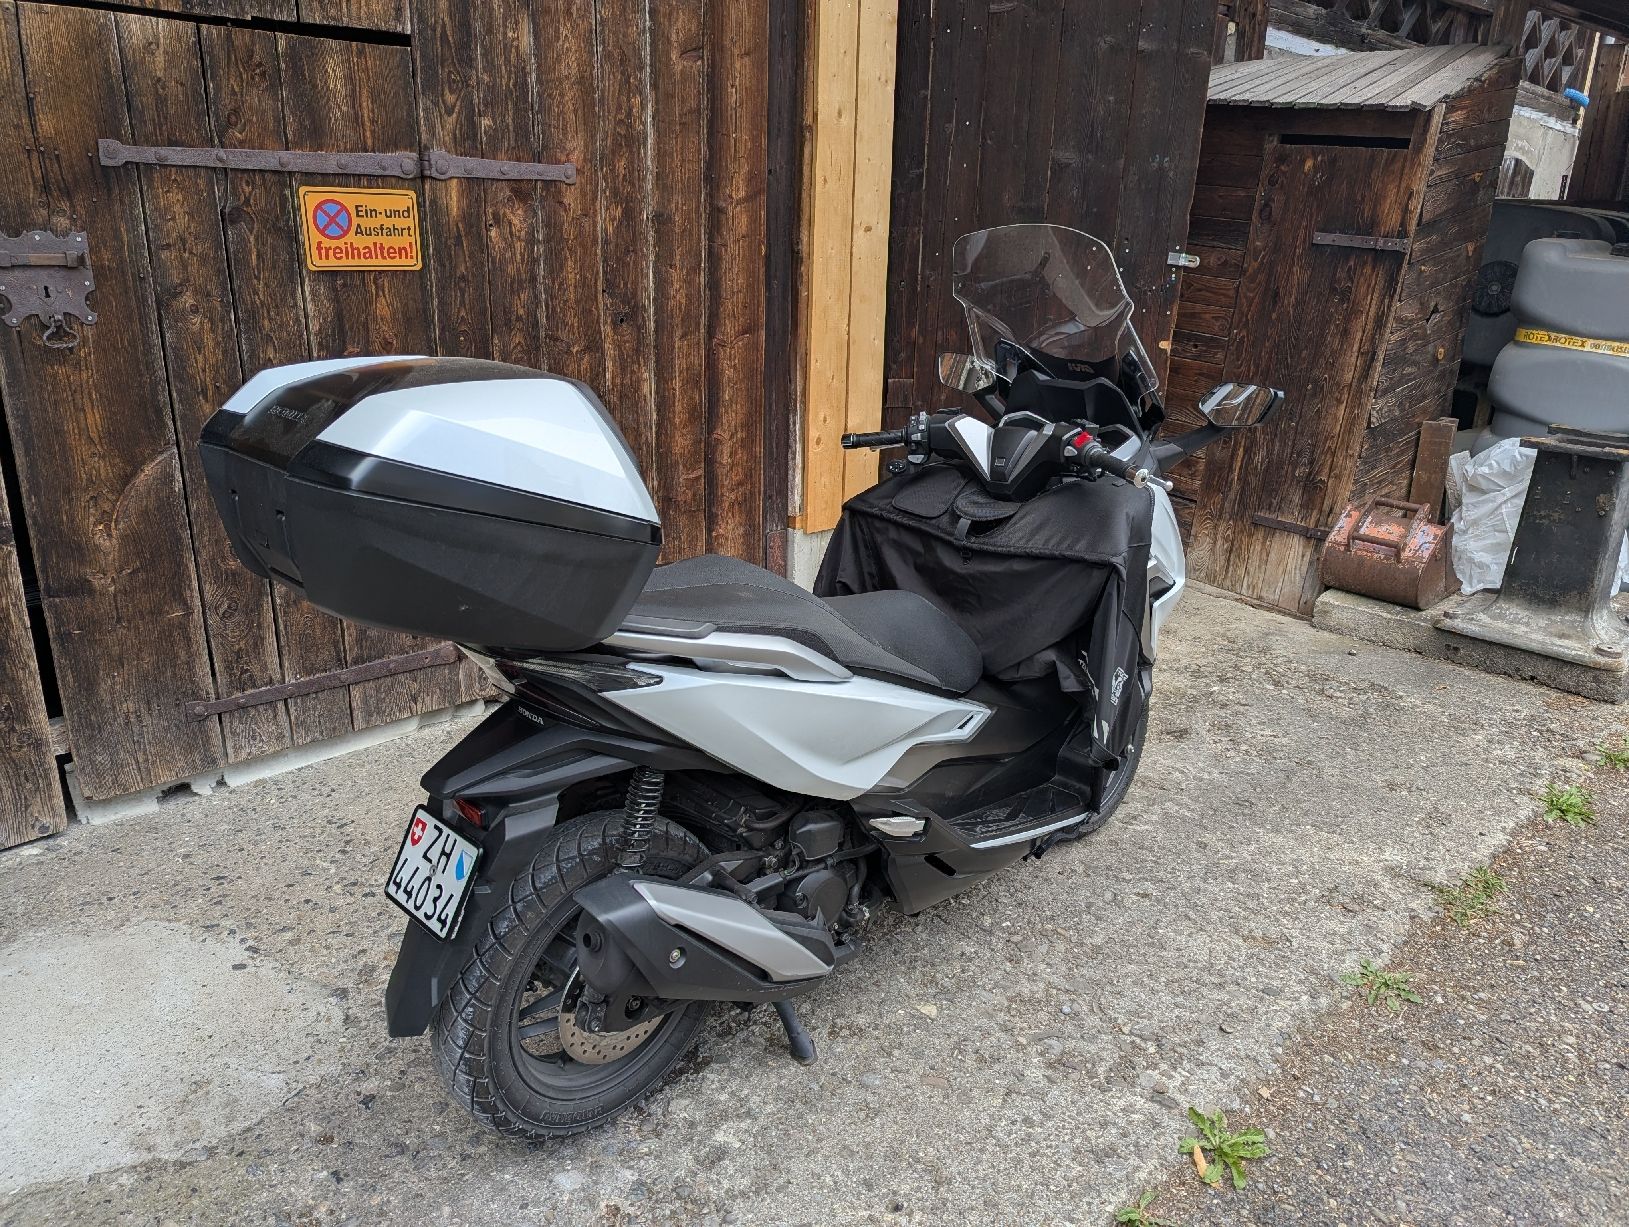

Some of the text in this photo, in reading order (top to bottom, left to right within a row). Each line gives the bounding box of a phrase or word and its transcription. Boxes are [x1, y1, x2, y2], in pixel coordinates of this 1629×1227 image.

[354, 223, 413, 237] Ausfahrt
[316, 241, 414, 260] freihalten!
[518, 706, 544, 725] HONDA
[422, 823, 457, 874] ZH
[392, 857, 454, 932] 44034
